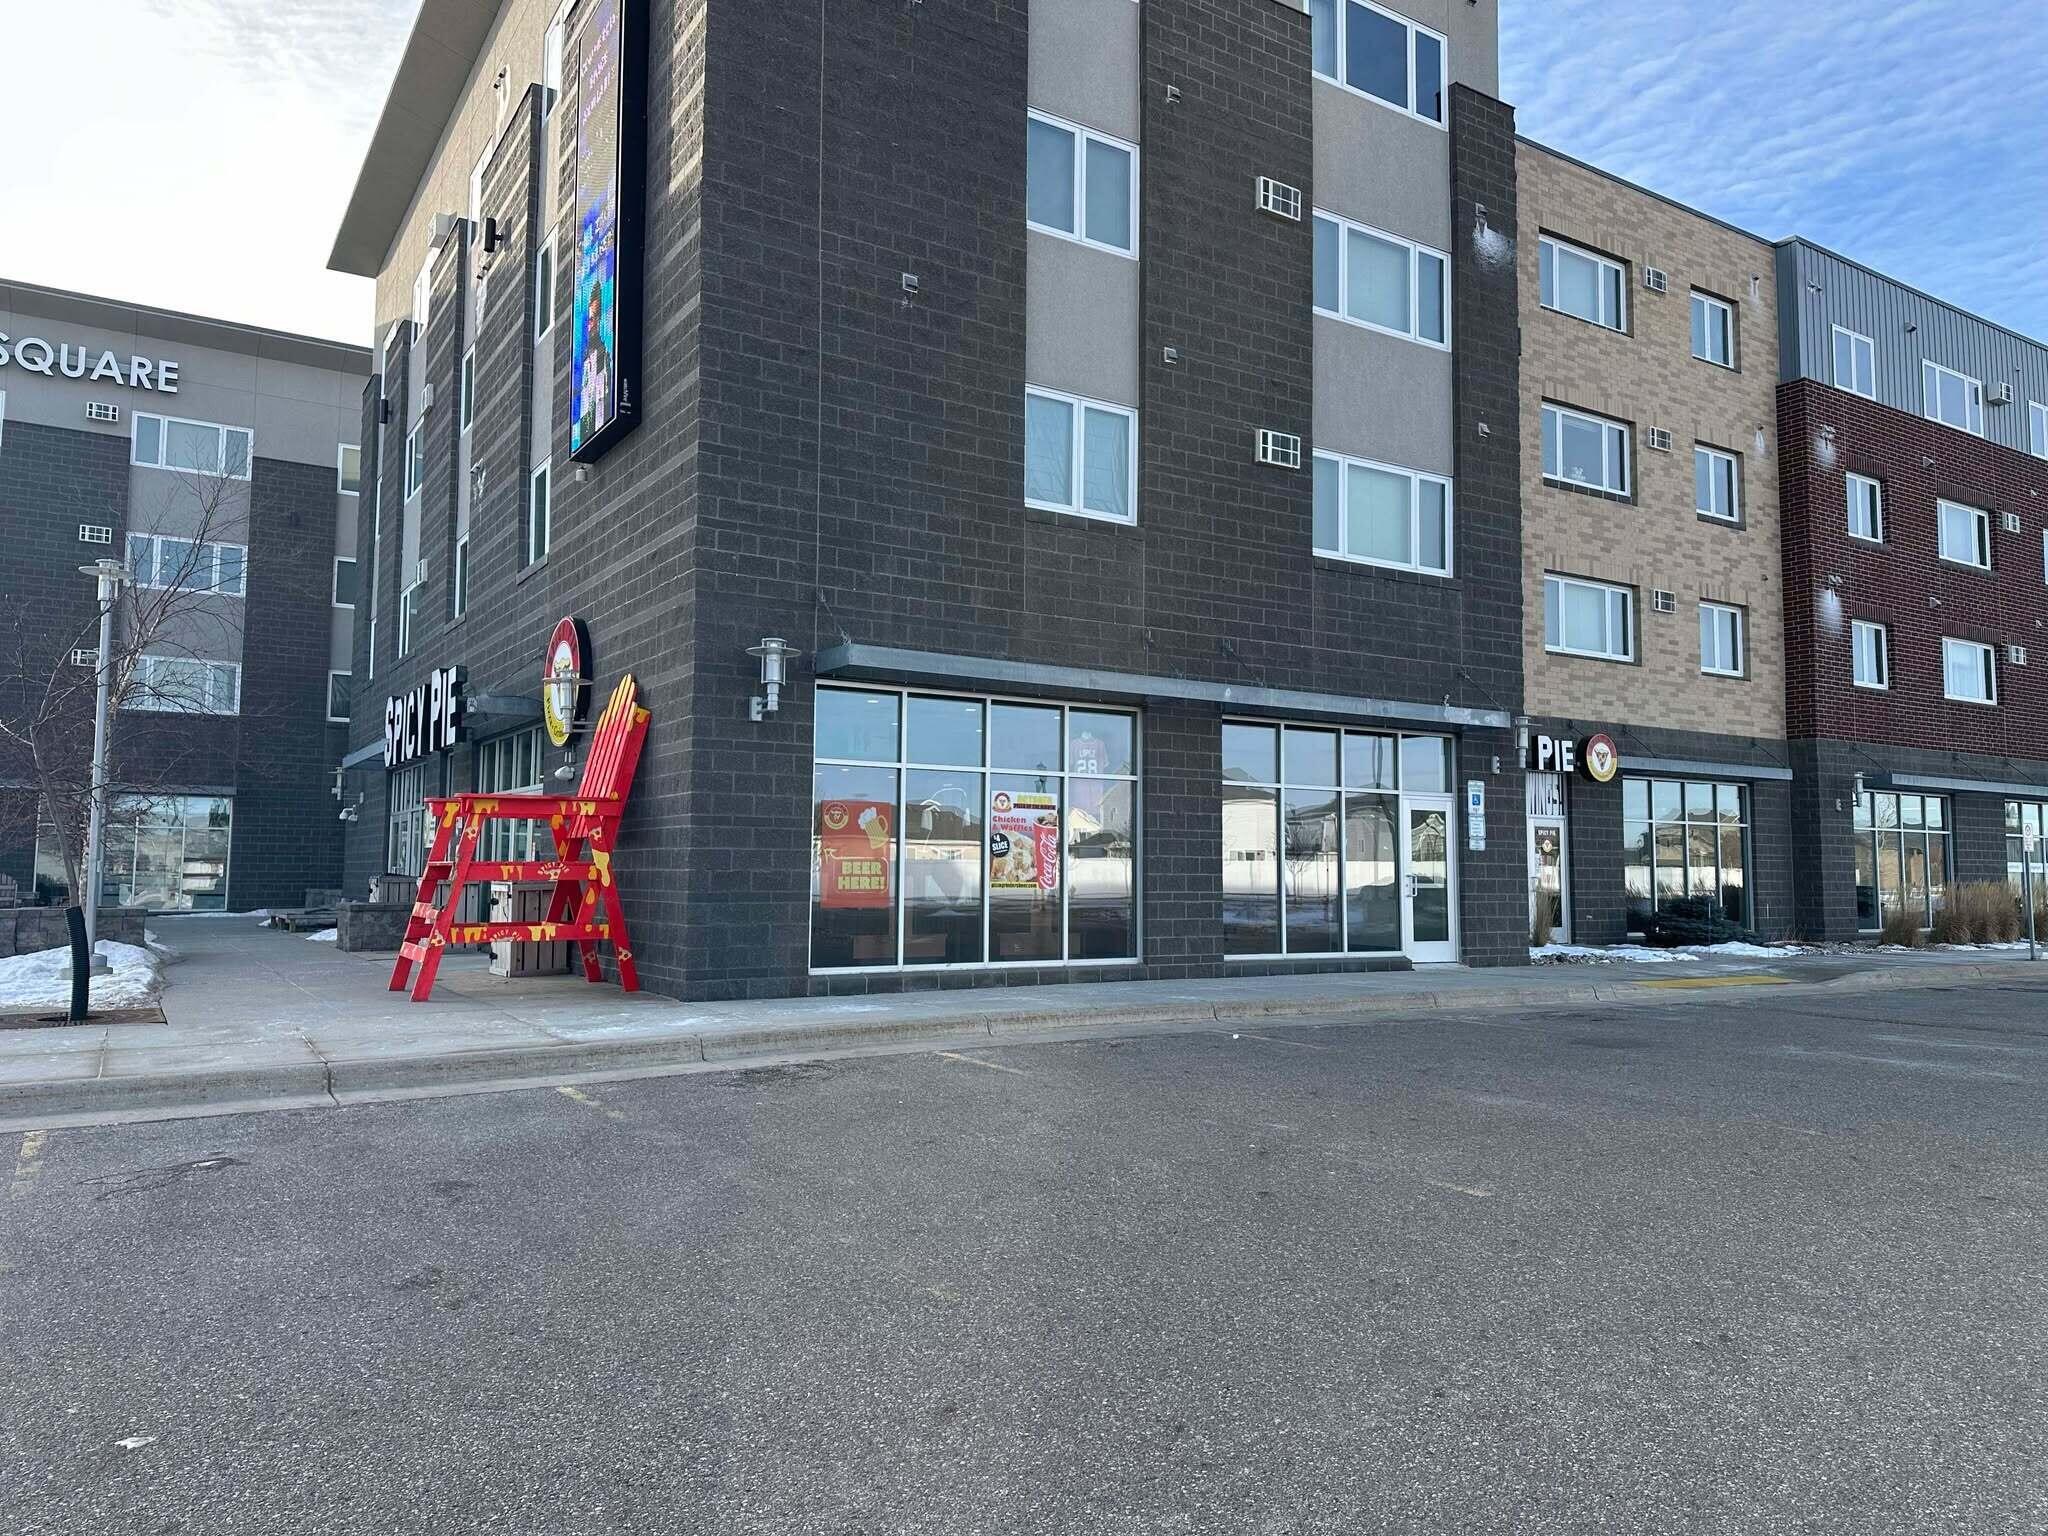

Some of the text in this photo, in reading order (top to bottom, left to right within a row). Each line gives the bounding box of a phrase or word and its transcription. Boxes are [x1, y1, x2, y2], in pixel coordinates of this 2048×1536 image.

[384, 684, 426, 768] SPICY
[429, 665, 457, 753] PIE
[1537, 735, 1574, 772] PIE
[992, 816, 1026, 824] Chicken
[1001, 824, 1033, 833] Waffles
[992, 841, 1009, 851] SLICE
[841, 861, 882, 875] BEER
[837, 876, 885, 890] HERE!
